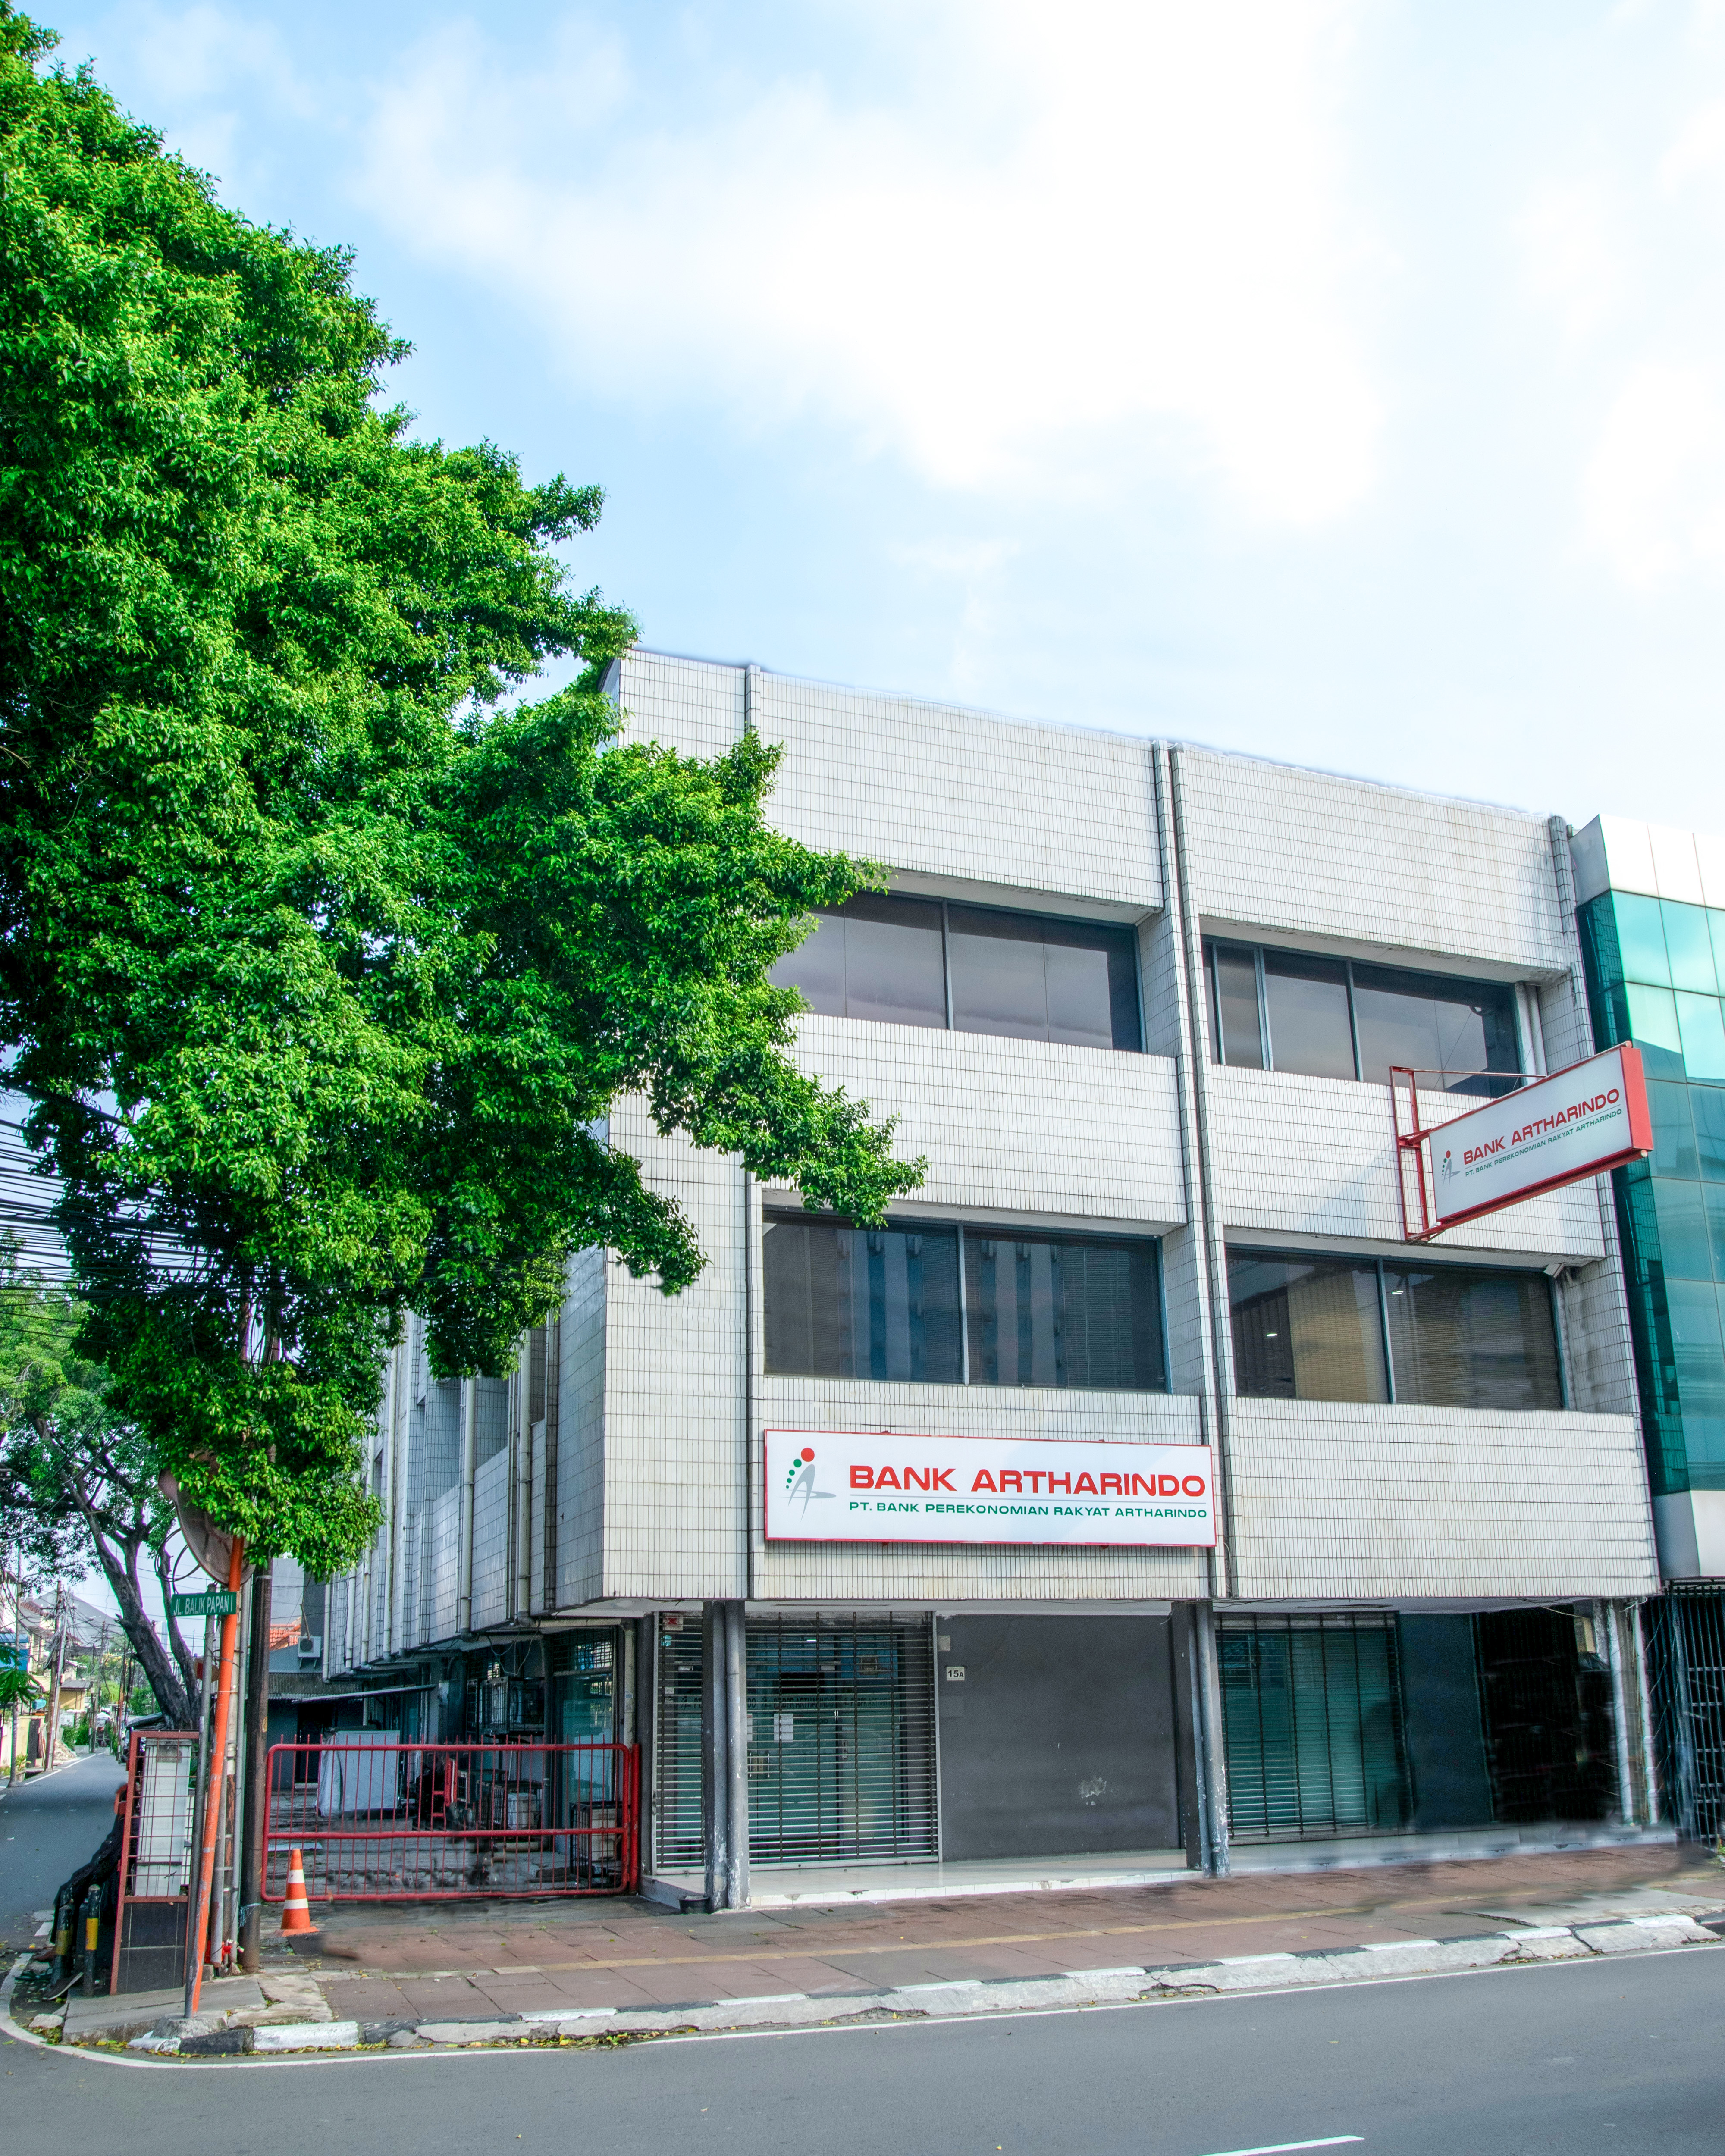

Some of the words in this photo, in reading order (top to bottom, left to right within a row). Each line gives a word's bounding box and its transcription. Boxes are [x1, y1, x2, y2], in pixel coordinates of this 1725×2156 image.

[1463, 1136, 1506, 1165] BANK
[1511, 1089, 1619, 1146] ARTHARINDO
[1476, 1162, 1493, 1173] BANK
[1494, 1140, 1546, 1165] PEREKONOMIAN
[1548, 1128, 1574, 1144] RAKYAT
[1576, 1109, 1622, 1132] ARTHARINDO
[850, 1465, 956, 1491] BANK
[971, 1469, 1206, 1497] ARTHARINDO
[850, 1502, 872, 1511] PT.
[877, 1503, 919, 1512] BANK
[925, 1504, 1048, 1515] PEREKONOMIAN
[1054, 1507, 1110, 1516] RAKYAT
[1115, 1508, 1207, 1518] ARTHARINDO
